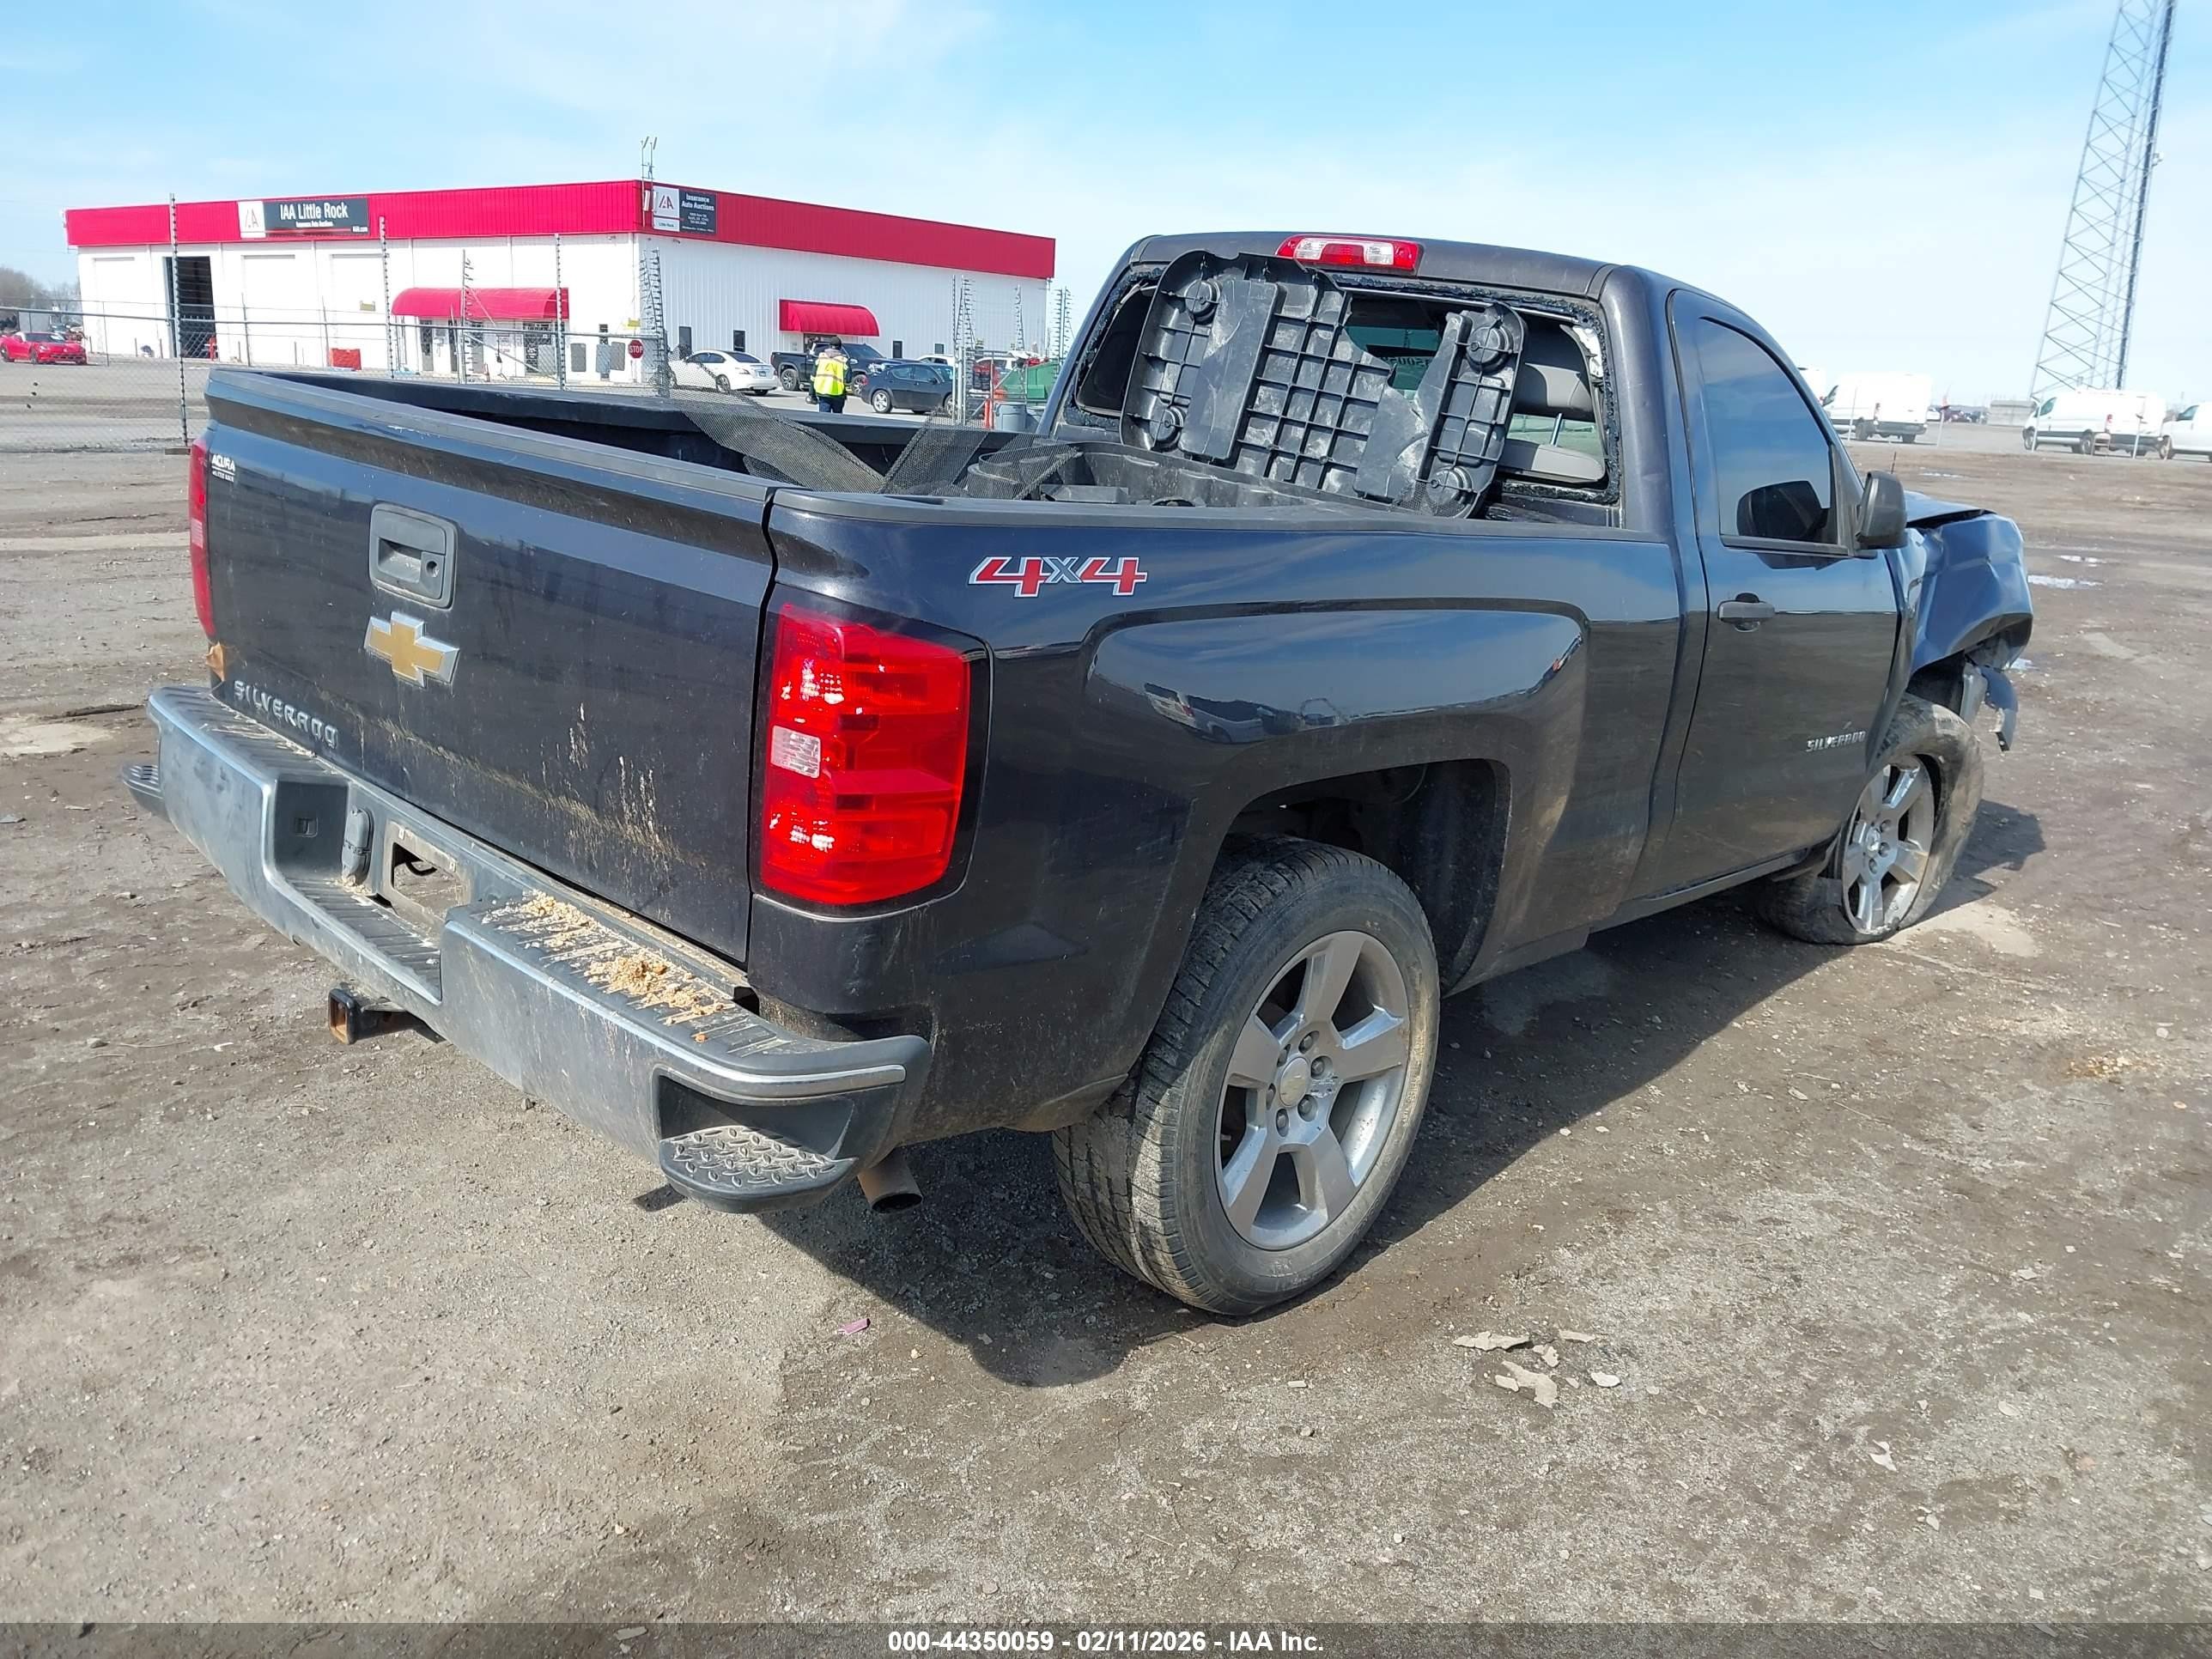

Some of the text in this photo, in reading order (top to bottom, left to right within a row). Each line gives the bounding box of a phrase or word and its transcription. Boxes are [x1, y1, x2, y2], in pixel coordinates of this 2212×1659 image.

[686, 194, 709, 203] Insurance
[694, 202, 714, 211] Auctions
[280, 202, 349, 220] IAA Little Rock
[629, 345, 643, 354] STOP
[211, 454, 235, 471] ACURA
[233, 680, 339, 750] SILVERADO
[1806, 731, 1866, 752] SILVERADO
